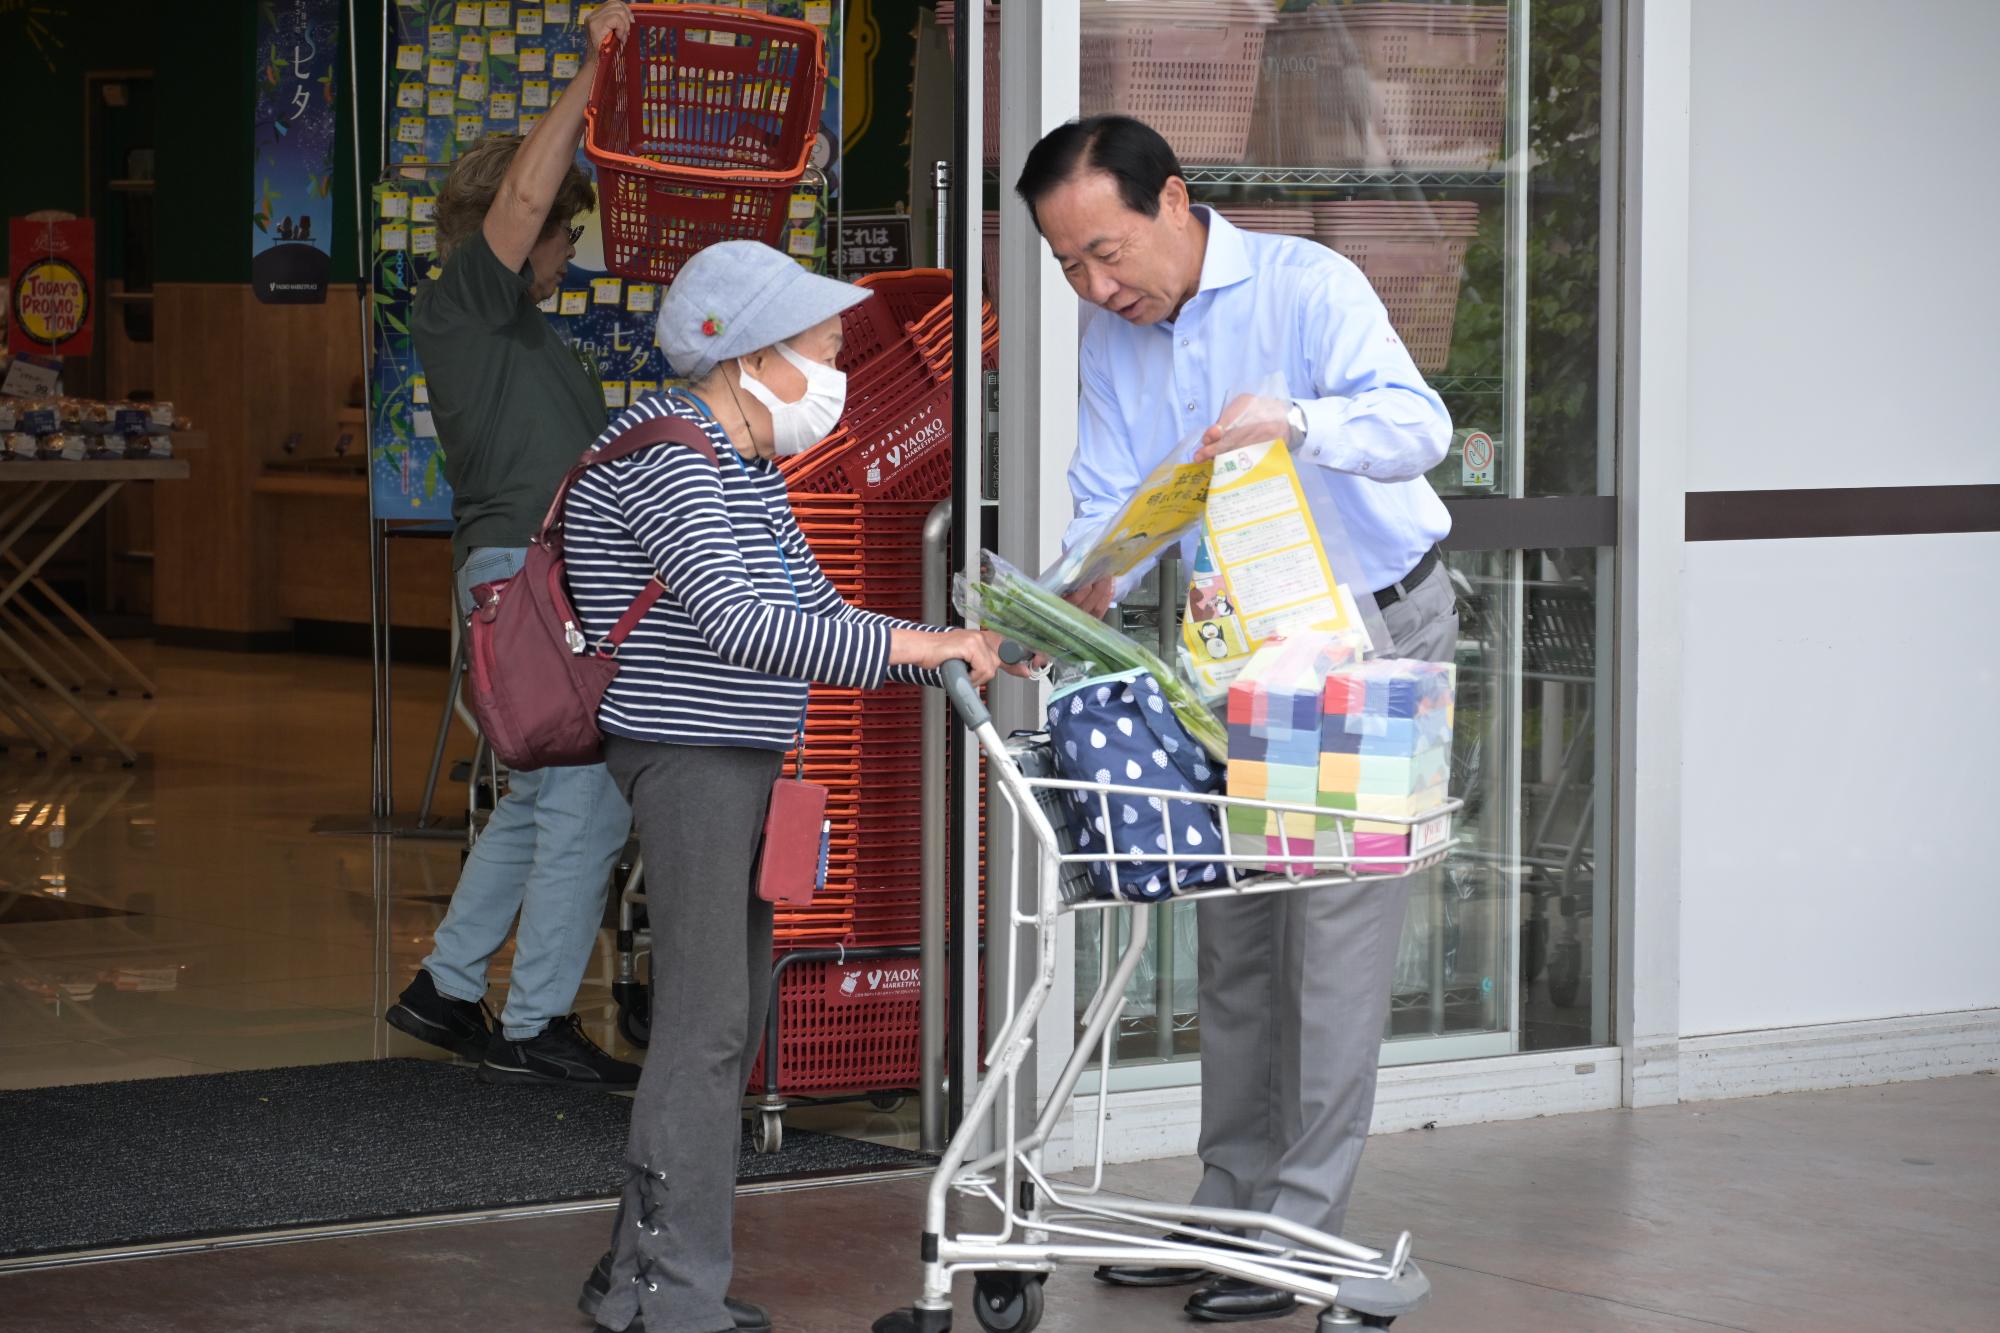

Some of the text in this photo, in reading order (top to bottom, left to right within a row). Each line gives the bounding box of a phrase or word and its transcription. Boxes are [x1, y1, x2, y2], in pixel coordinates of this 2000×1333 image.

[841, 227, 889, 246] これは
[831, 246, 898, 265] お酒です
[899, 418, 943, 453] YAOKO
[884, 968, 920, 982] YAOK
[882, 981, 920, 989] MARKETPLA
